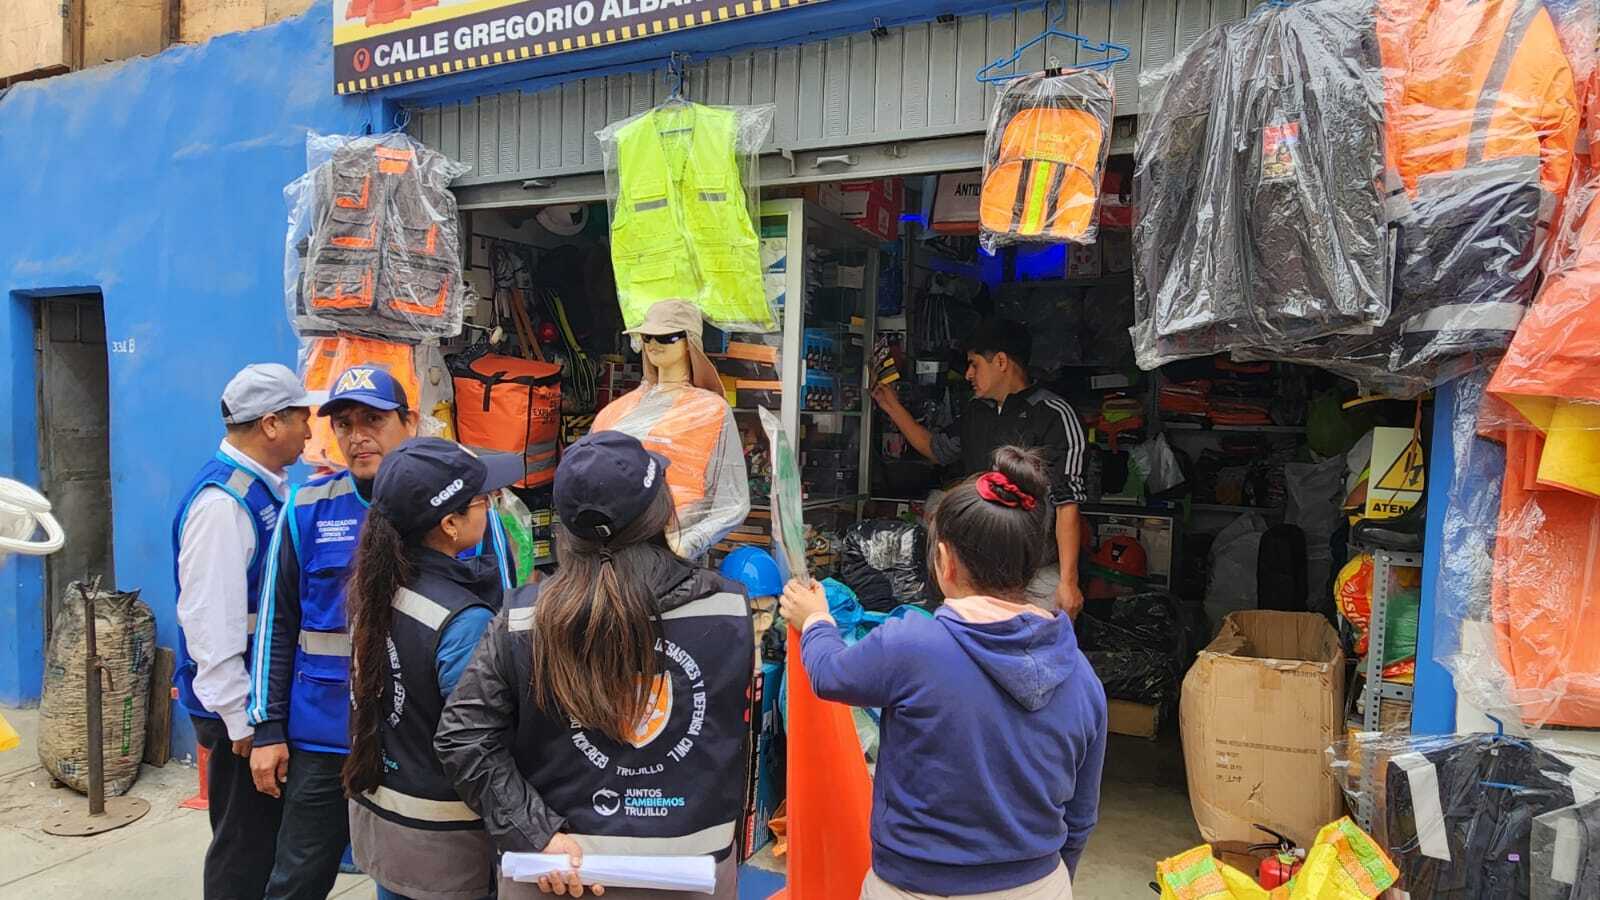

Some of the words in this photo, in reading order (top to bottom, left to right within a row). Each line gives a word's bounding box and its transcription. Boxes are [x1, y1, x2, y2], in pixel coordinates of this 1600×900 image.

[374, 32, 449, 67] CALLE
[454, 1, 595, 50] GREGORIO
[430, 478, 464, 506] GGRD
[654, 637, 701, 680] DSASTRES
[692, 679, 705, 689] Y
[688, 691, 706, 736] DEFENSA
[666, 737, 694, 762] CIVIL
[616, 763, 664, 777] TRUJILLO
[624, 788, 662, 798] JUNTOS
[624, 797, 685, 807] CAMBIEMOS
[624, 806, 668, 817] TRUJILLO
